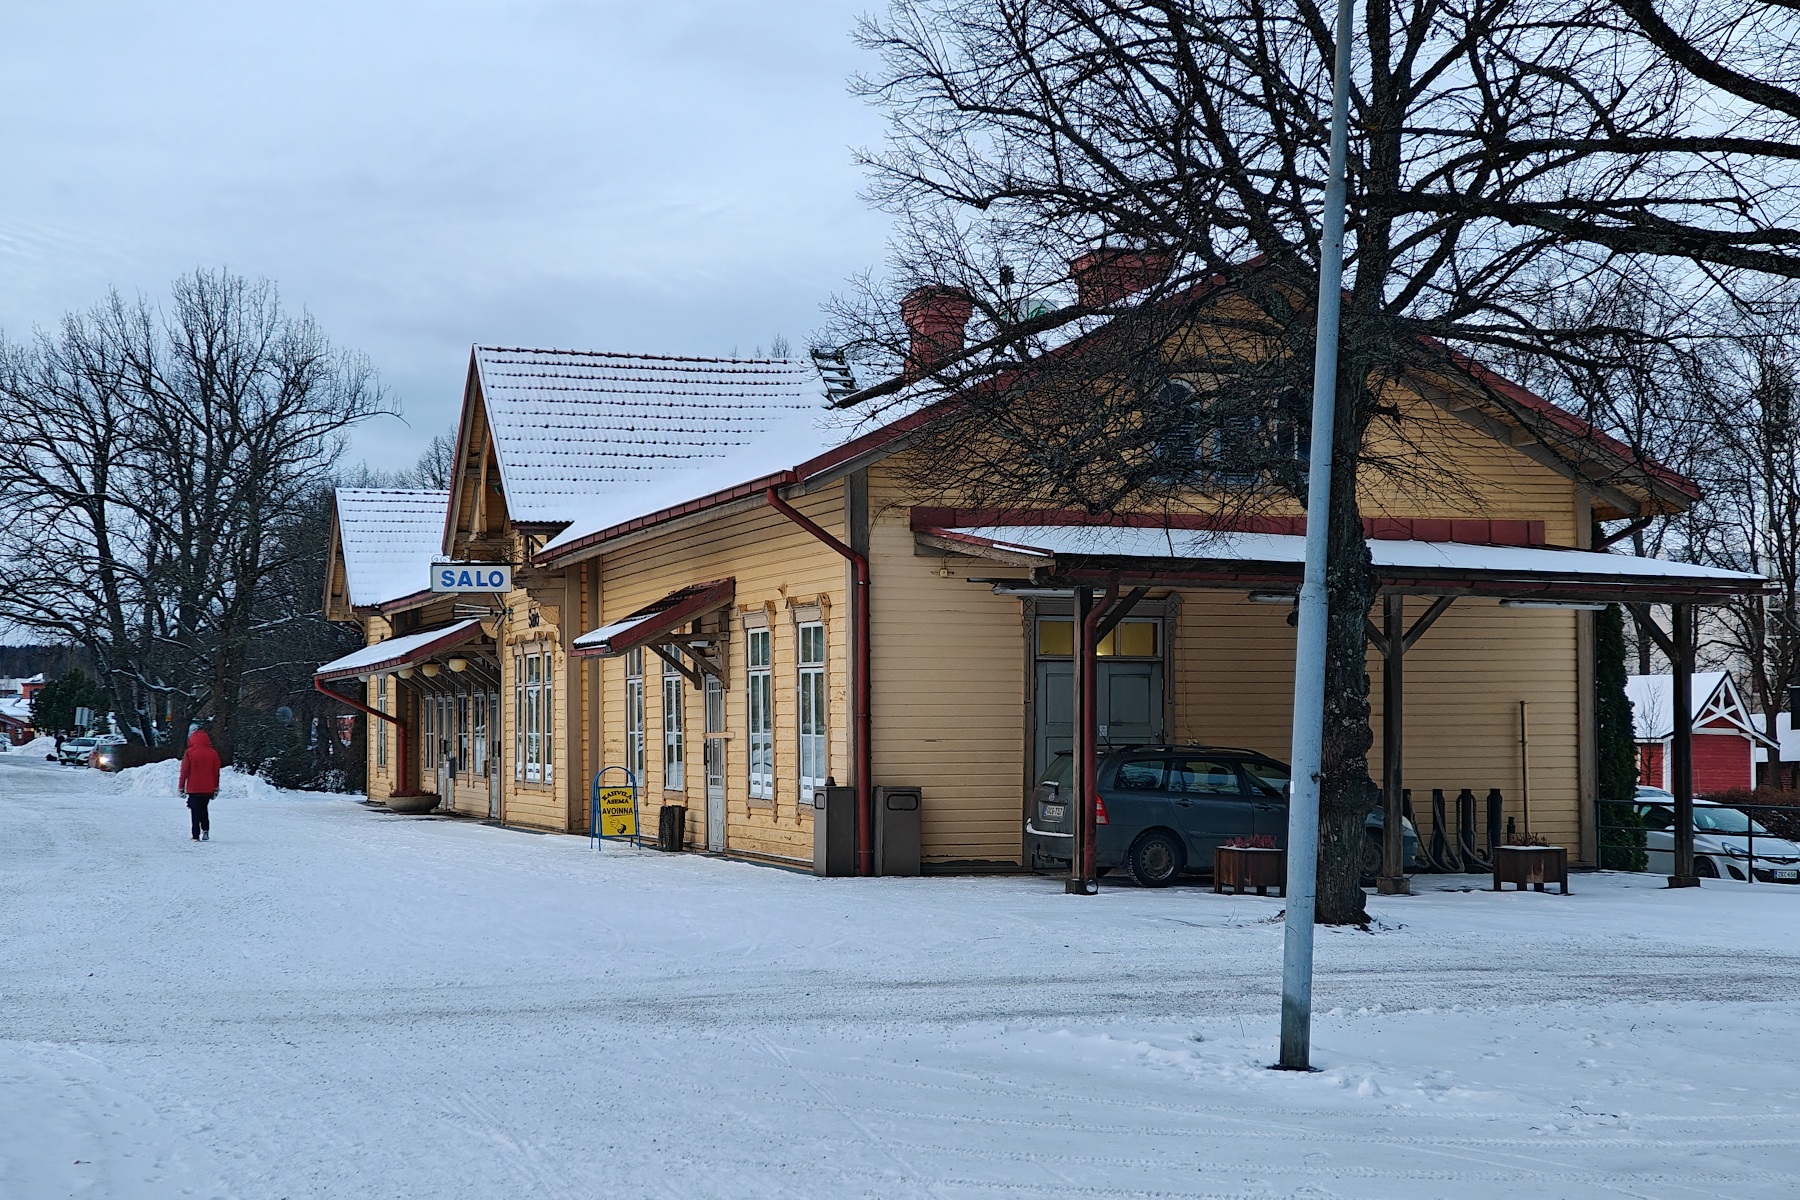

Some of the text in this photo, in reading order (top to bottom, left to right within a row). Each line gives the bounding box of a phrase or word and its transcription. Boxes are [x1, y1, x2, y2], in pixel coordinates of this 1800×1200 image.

[441, 570, 504, 587] SALO
[602, 790, 632, 801] KAHVILA
[602, 807, 633, 815] AVOINNA
